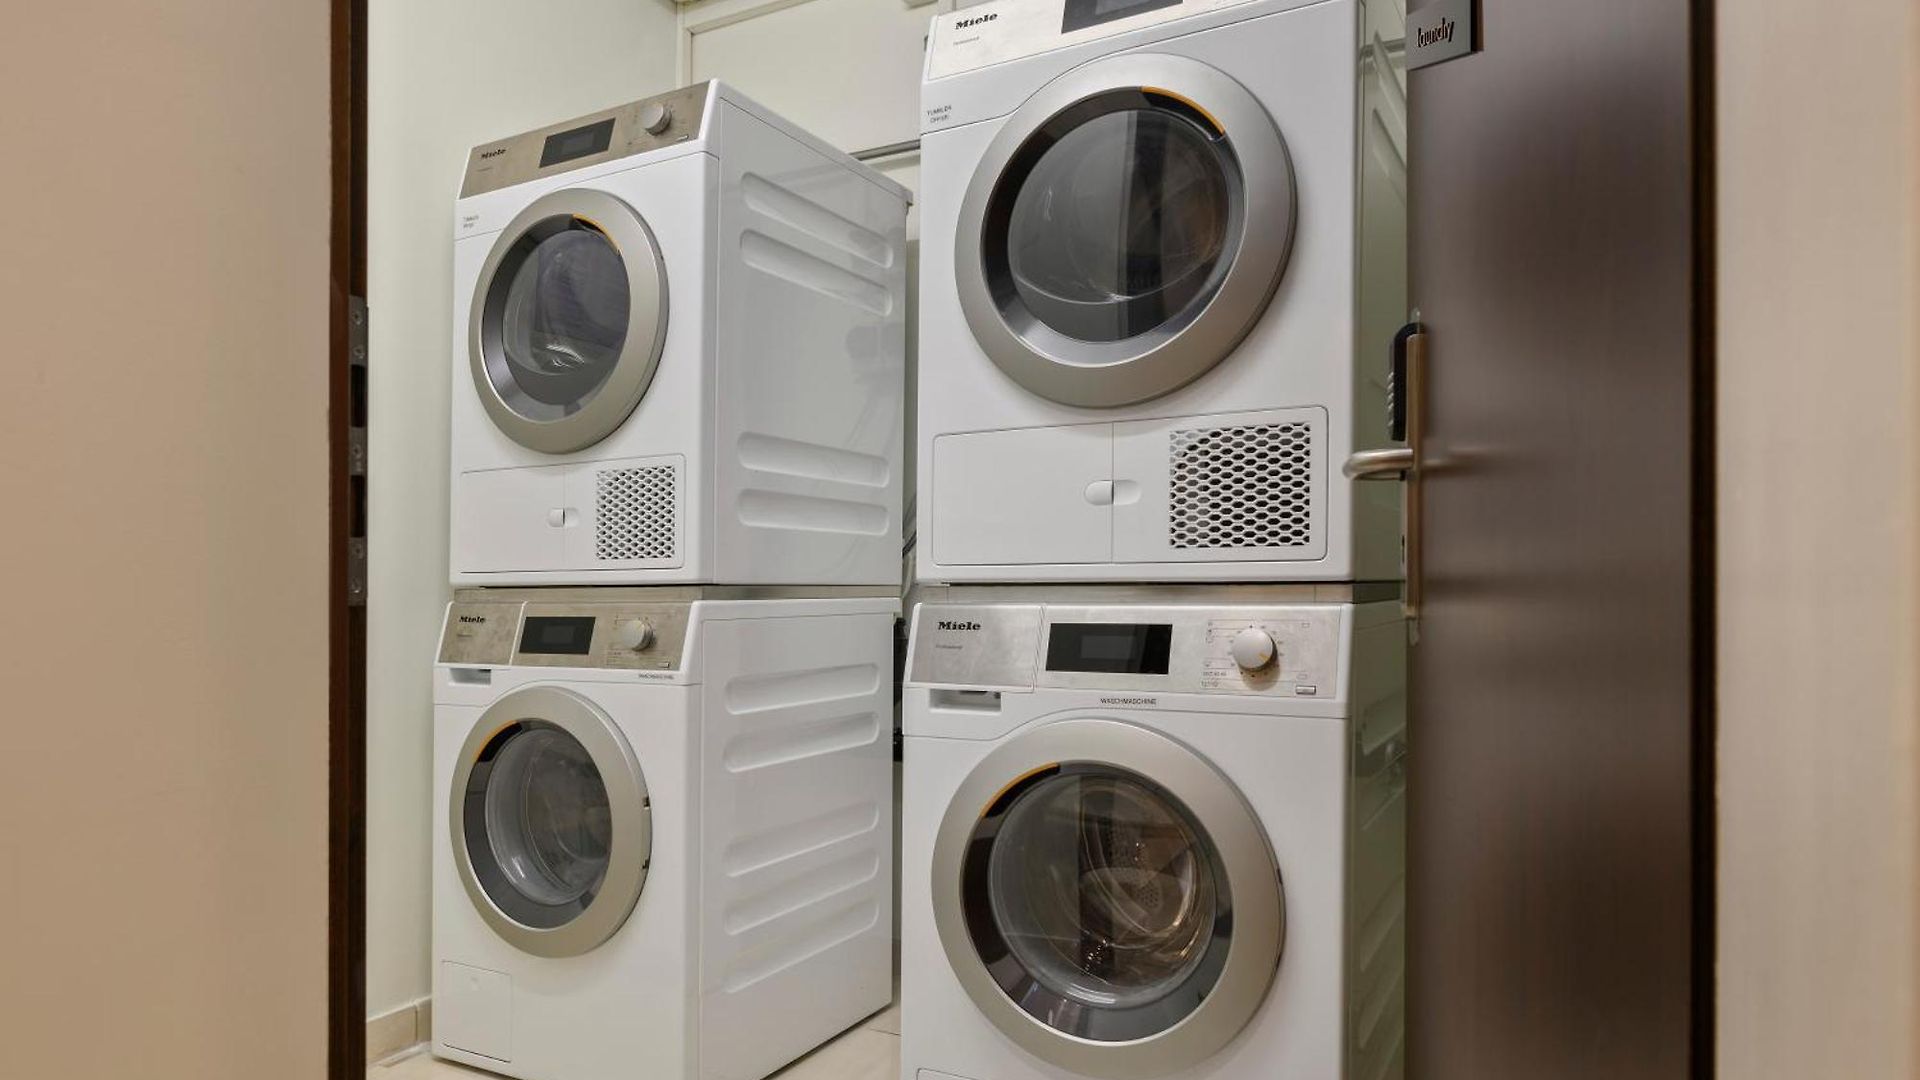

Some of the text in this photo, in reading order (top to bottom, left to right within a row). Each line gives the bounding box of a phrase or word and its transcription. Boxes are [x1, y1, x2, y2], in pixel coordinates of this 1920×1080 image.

[955, 13, 998, 30] Miele
[1417, 17, 1455, 48] laundry
[481, 149, 506, 158] Miele
[459, 615, 486, 624] Miele
[937, 621, 981, 631] Miele
